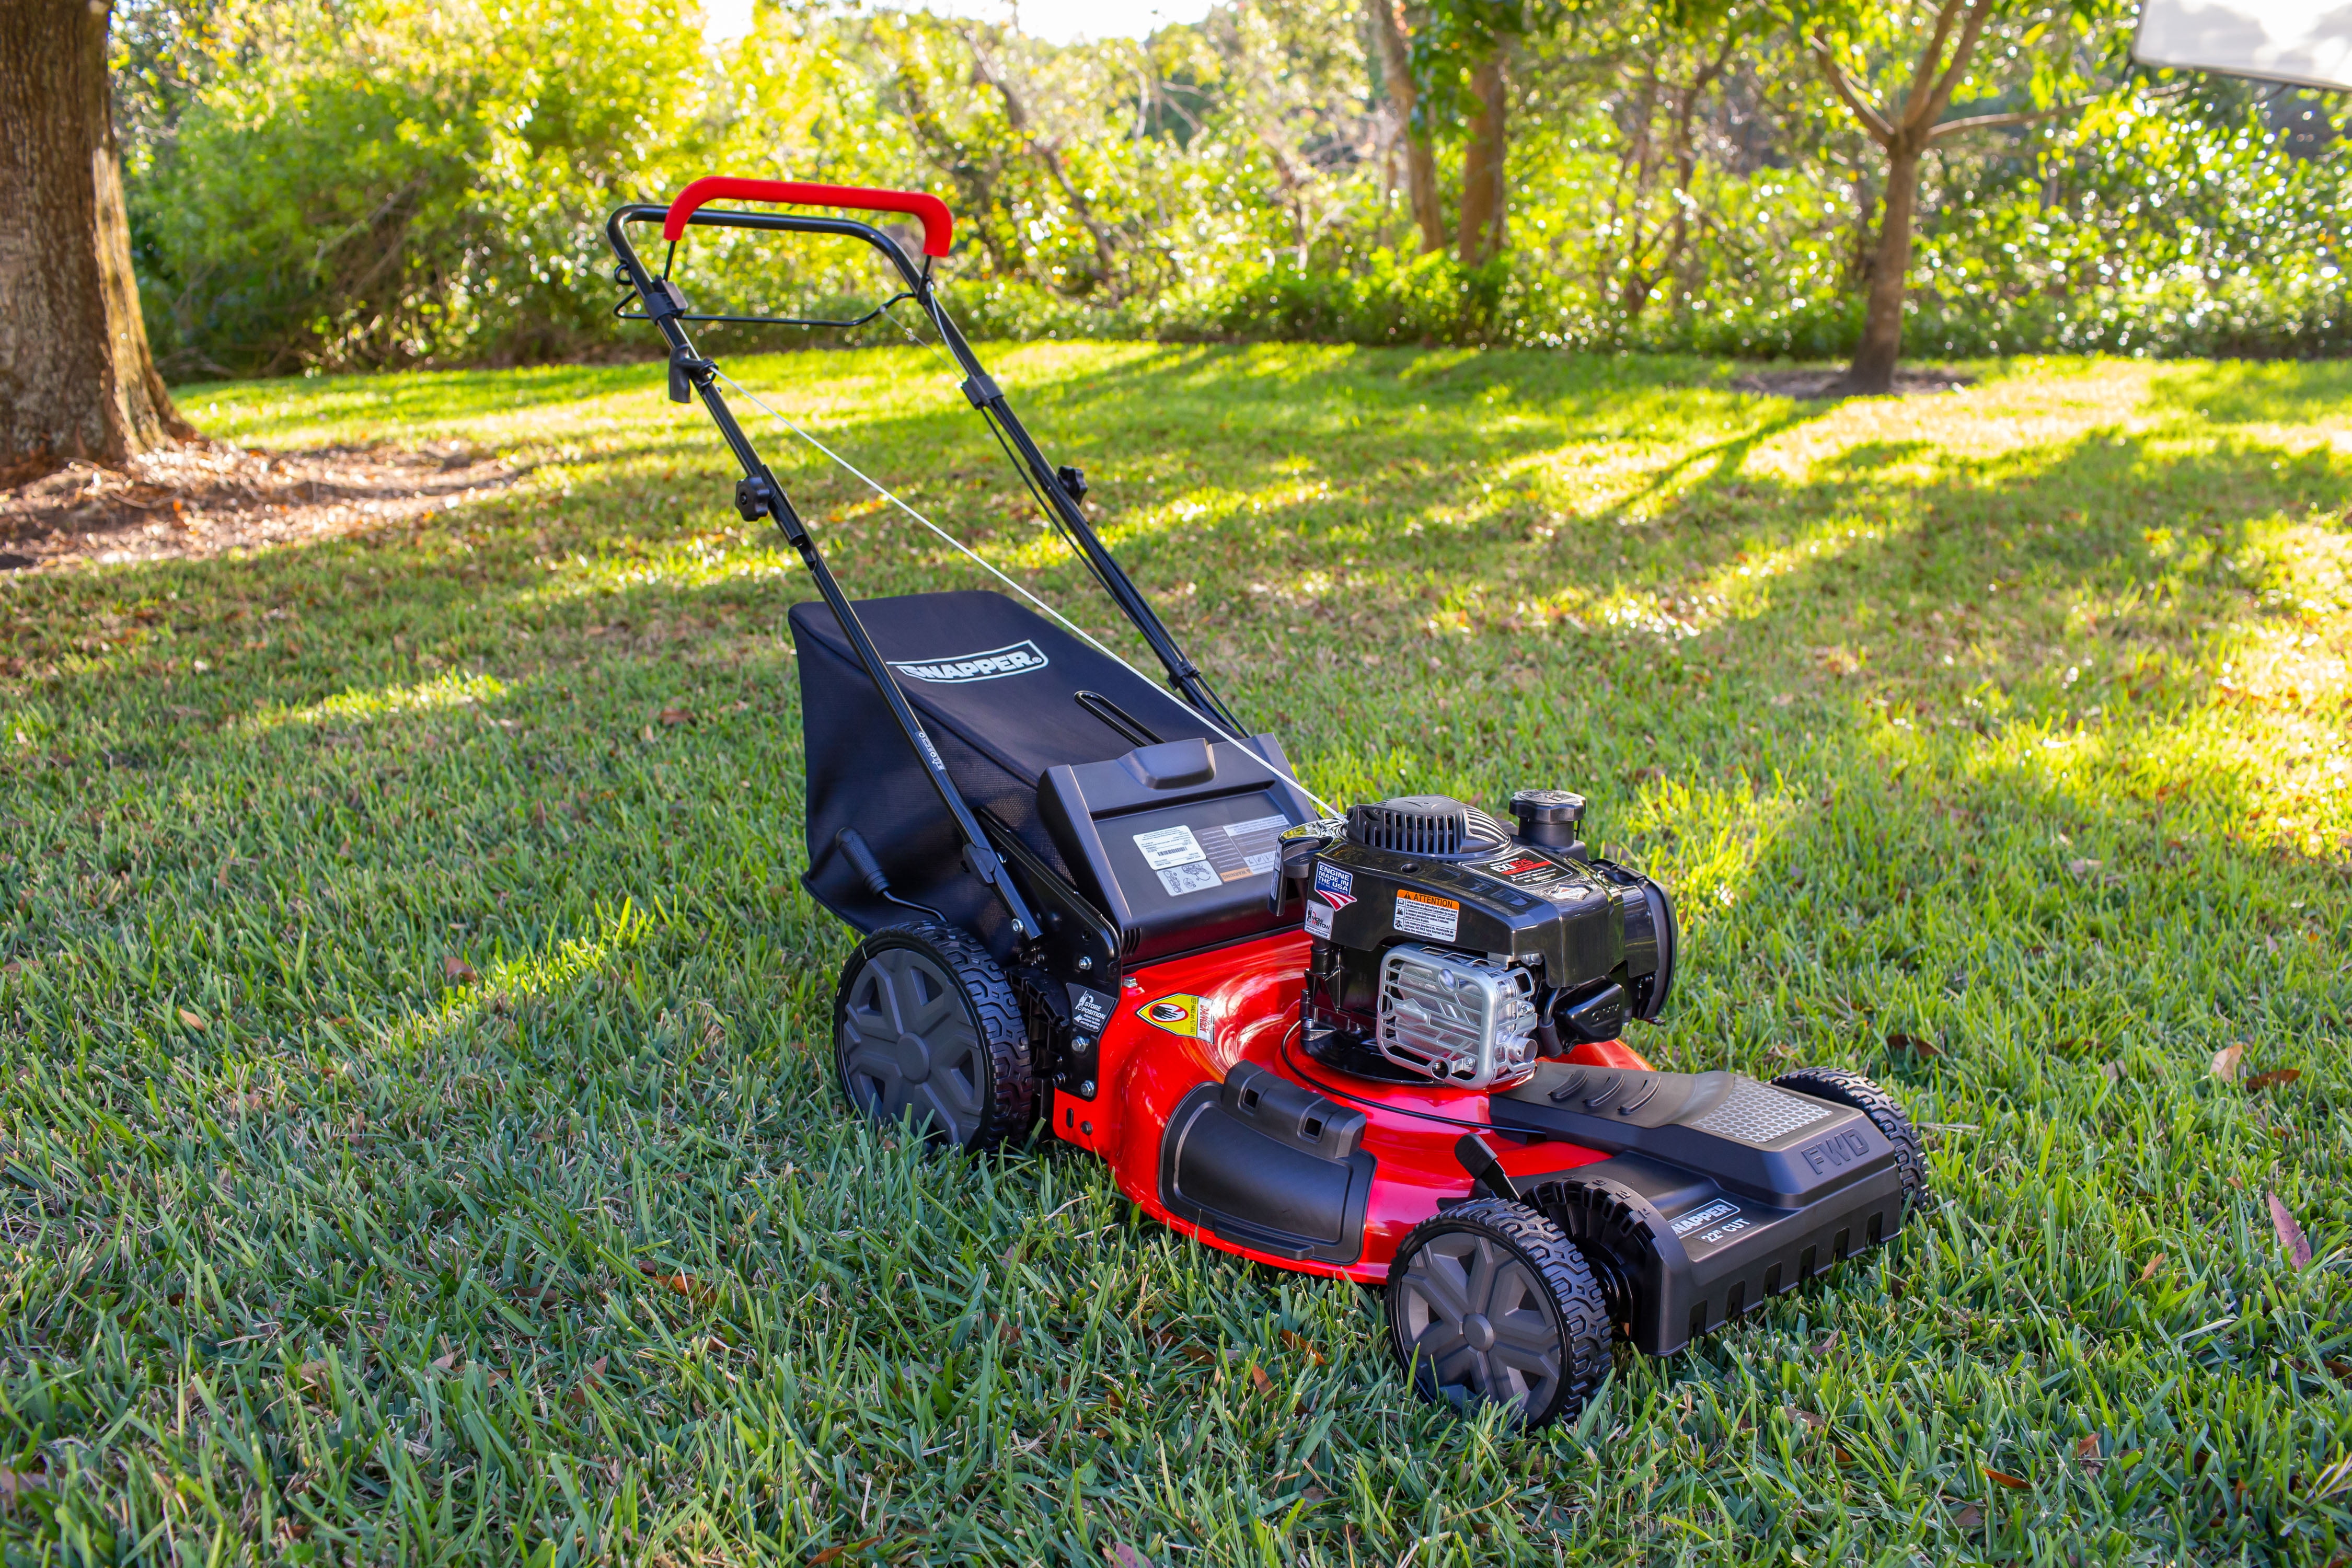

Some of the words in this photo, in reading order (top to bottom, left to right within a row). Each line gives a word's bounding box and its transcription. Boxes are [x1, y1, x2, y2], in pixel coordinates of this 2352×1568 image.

[1222, 870, 1247, 879] WARNING
[1319, 864, 1350, 881] ENGINE
[1319, 871, 1339, 882] MADE
[1318, 875, 1330, 885] THE
[1332, 882, 1348, 892] USA
[1413, 893, 1452, 908] ATTENTION
[1081, 1007, 1106, 1020] POSITION
[1085, 1001, 1102, 1011] STORE
[1200, 1005, 1209, 1034] DANGER
[1801, 1128, 1870, 1175] FWD
[1671, 1204, 1732, 1235] NAPPER
[1721, 1218, 1750, 1232] CUT
